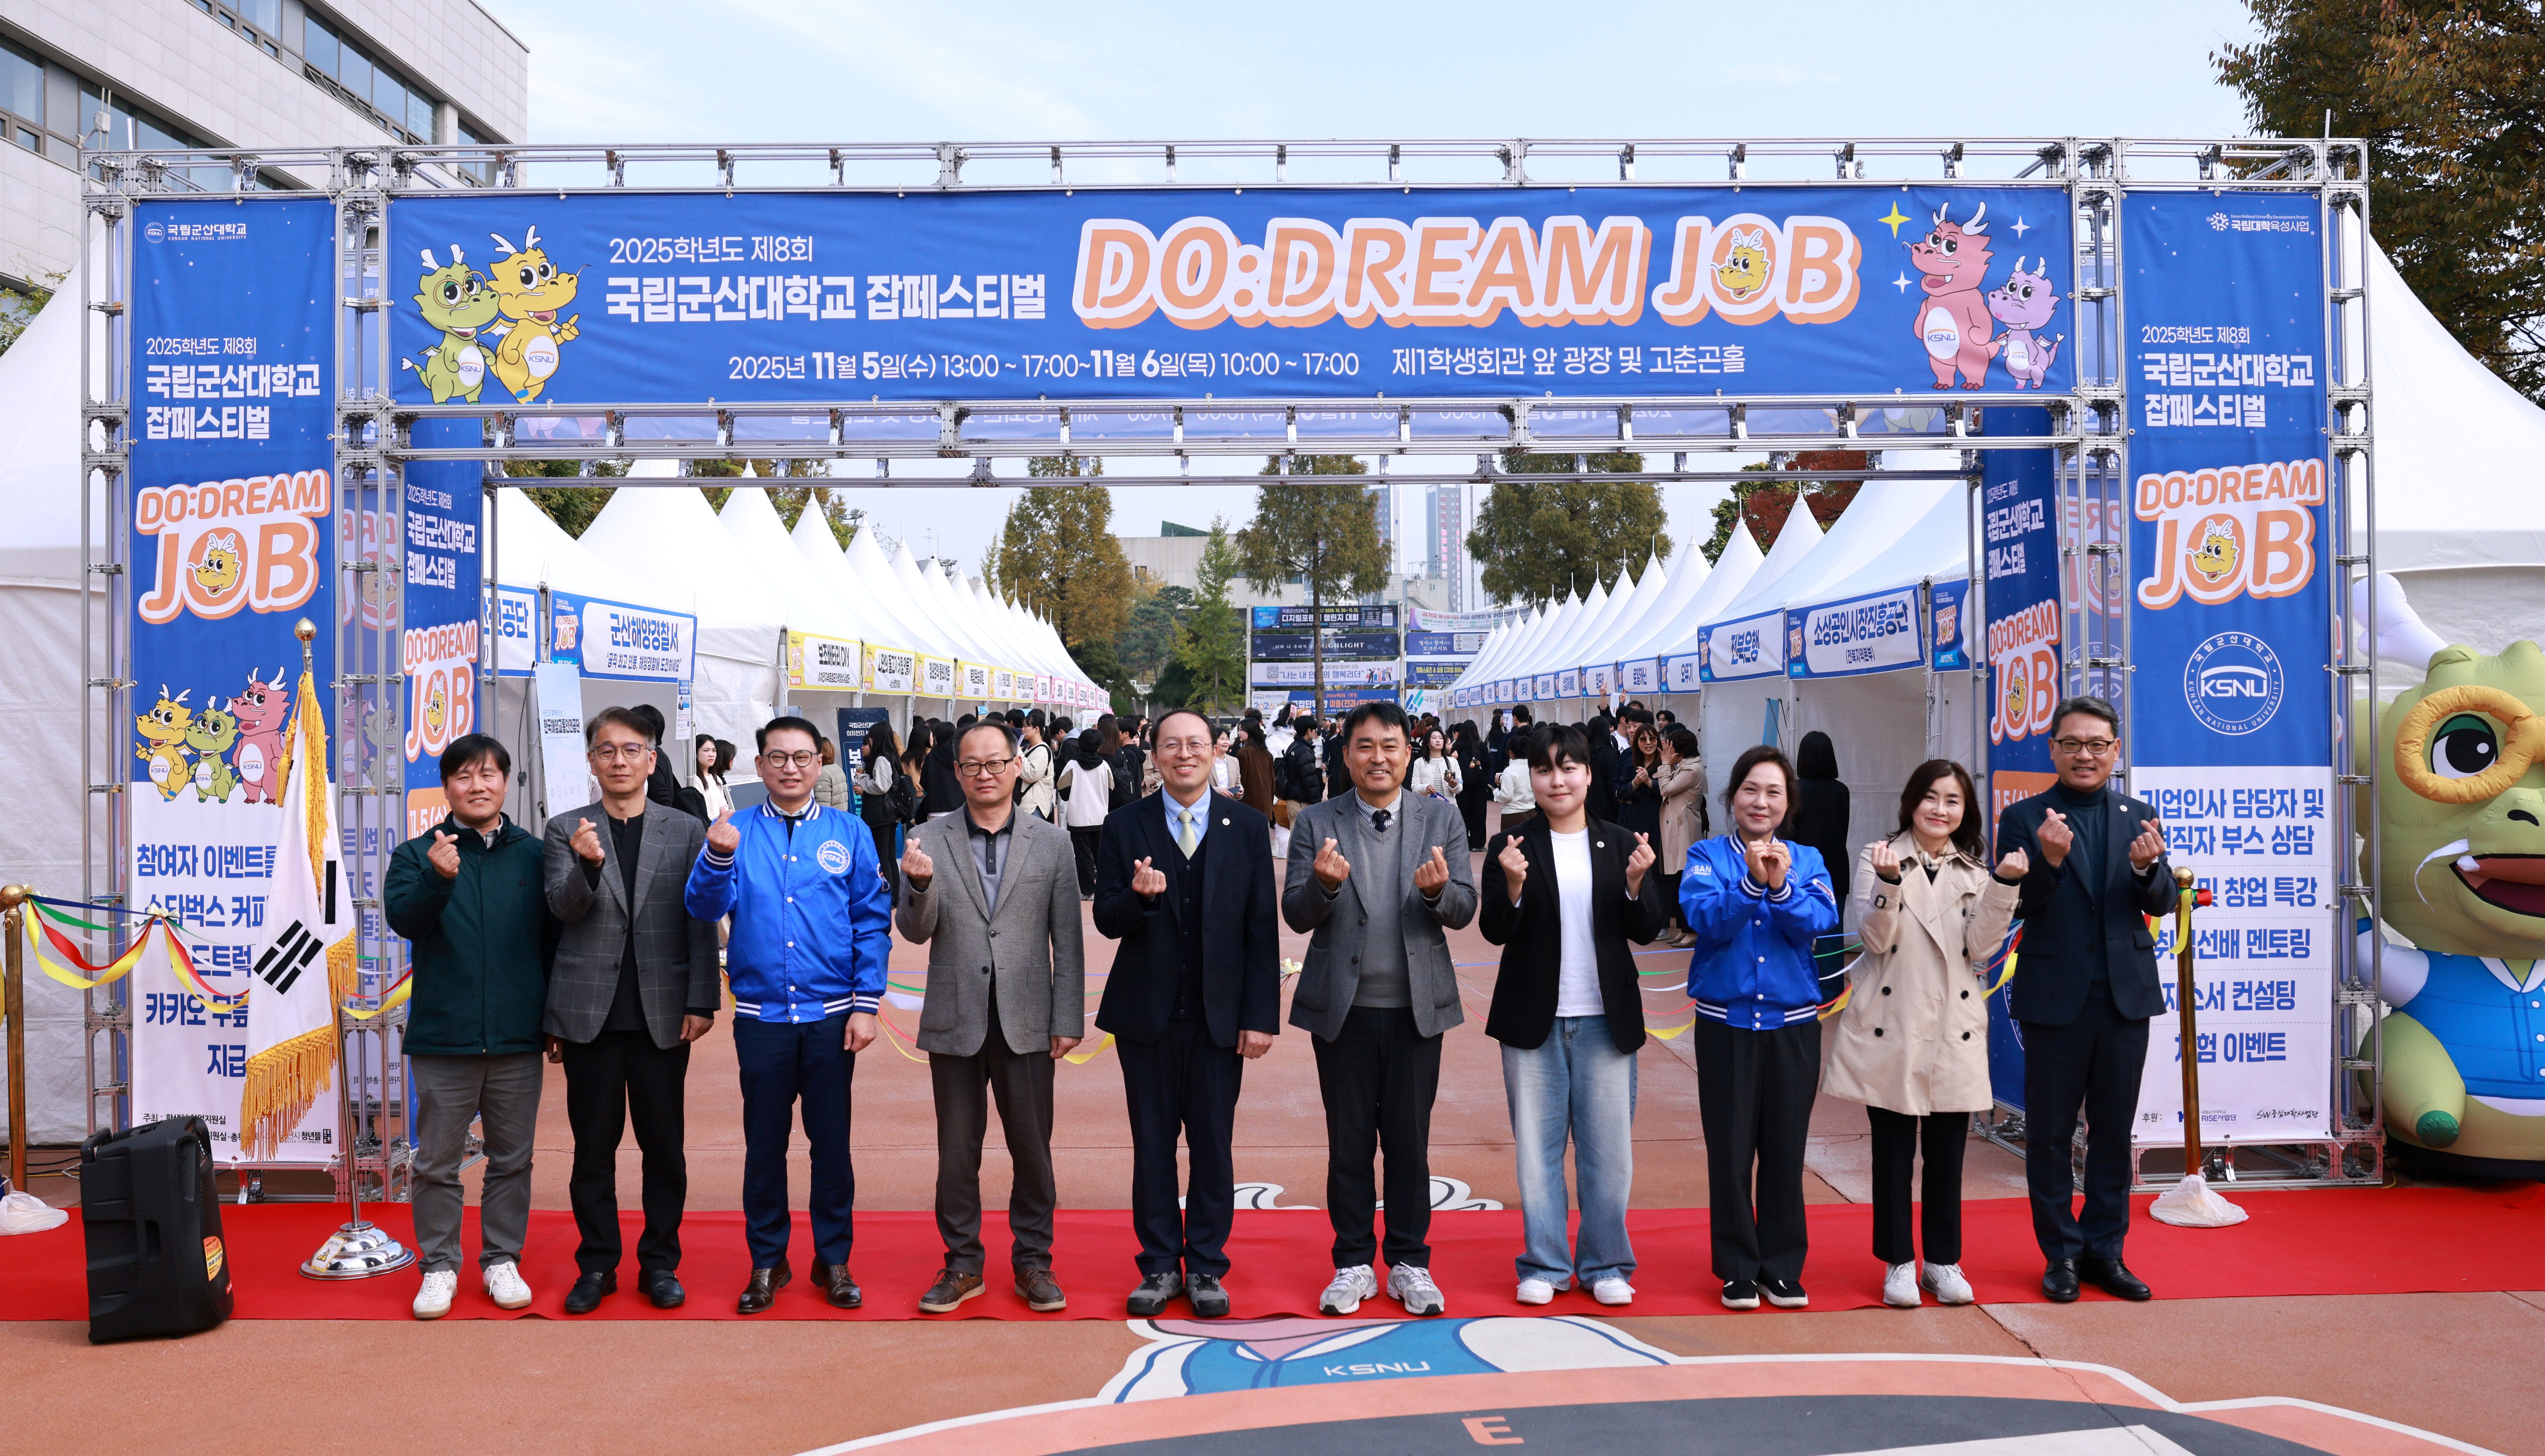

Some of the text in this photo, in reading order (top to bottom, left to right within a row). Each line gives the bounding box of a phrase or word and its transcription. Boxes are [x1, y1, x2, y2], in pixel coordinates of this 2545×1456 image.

[168, 223, 246, 236] 국립군산대학교
[2231, 220, 2309, 232] 국립대학육성사업
[610, 236, 813, 263] 2025학년도 제8회
[1073, 214, 1862, 328] DO:DREAM JOB
[606, 274, 1045, 323] 국립군산대학교 잡페스티벌
[146, 337, 256, 355] 2025학년도 제8회
[1927, 333, 1956, 342] KSNU
[2142, 326, 2250, 344] 2025학년도 제8회
[729, 356, 805, 379] 2025년
[812, 352, 856, 379] 11월
[862, 351, 935, 379] 5일(수)
[942, 354, 999, 378] 13:00
[1141, 350, 1215, 377] 6일(목)
[1221, 352, 1280, 376] 10:00
[1302, 352, 1359, 376] 17:00
[1392, 345, 1745, 376] 제1학생회관 앞 광장 및 고춘곤홀
[2143, 354, 2314, 387] 국립군산대학교
[147, 364, 320, 399] 국립군산대학교
[146, 406, 269, 439] 잡페스티벌
[2145, 394, 2266, 427] 잡페스티벌
[136, 470, 330, 533] DO:DREAM
[407, 484, 452, 510] 2025학년도 제8회
[2136, 459, 2324, 519] DO:DREAM
[407, 510, 475, 553] 국립군산대학교
[138, 515, 319, 624] JOB
[407, 550, 455, 589] 잡페스티벌
[2138, 506, 2315, 609] JOB
[555, 615, 578, 627] DO:DREAM
[1323, 613, 1344, 621] 챌린지
[1814, 599, 1909, 646] 소상공인시장진흥공단
[1936, 604, 1957, 622] DO:DREAM
[404, 620, 478, 672] DO:DREAM
[555, 626, 577, 651] JOB
[610, 613, 678, 652] 군산해양경찰서
[1936, 617, 1955, 646] JOB
[1989, 599, 2060, 665] DO:DREAM
[618, 653, 627, 669] 최고
[818, 643, 850, 667] 보조배터리 DIY
[1731, 629, 1760, 665] 전북은행
[1790, 636, 1802, 659] JOB
[1846, 645, 1876, 664] (전북지역본부)
[2194, 635, 2273, 664] 국립군산대학교
[1681, 662, 1693, 683] 오뚜기
[1991, 645, 2059, 745] JOB
[2200, 679, 2267, 697] KSNU
[405, 664, 474, 761] JOB
[1253, 702, 1275, 711] 2026
[544, 718, 580, 734] 한국해양교통안전공단
[2139, 788, 2324, 819] 기업인사 담당자 및
[2222, 825, 2264, 855] 부스
[2271, 825, 2314, 855] 상담
[137, 844, 198, 877] 참여자
[823, 852, 844, 864] KSNU
[2224, 877, 2267, 907] 창업
[2274, 877, 2318, 907] 특강
[2154, 928, 2310, 960] 취선배 멘토링
[172, 944, 251, 978] 드트럭
[146, 993, 206, 1026] 카카오
[2233, 980, 2296, 1011] 컨설팅
[207, 1044, 247, 1077] 지급
[2224, 1032, 2286, 1063] 이벤트
[143, 1113, 158, 1123] 주최
[2142, 1113, 2158, 1123] 후원
[2256, 1108, 2319, 1120] SW중심대학사업단
[301, 1131, 321, 1140] 청년뜰
[1323, 1360, 1430, 1377] KSNU
[1461, 1415, 1525, 1446] E
